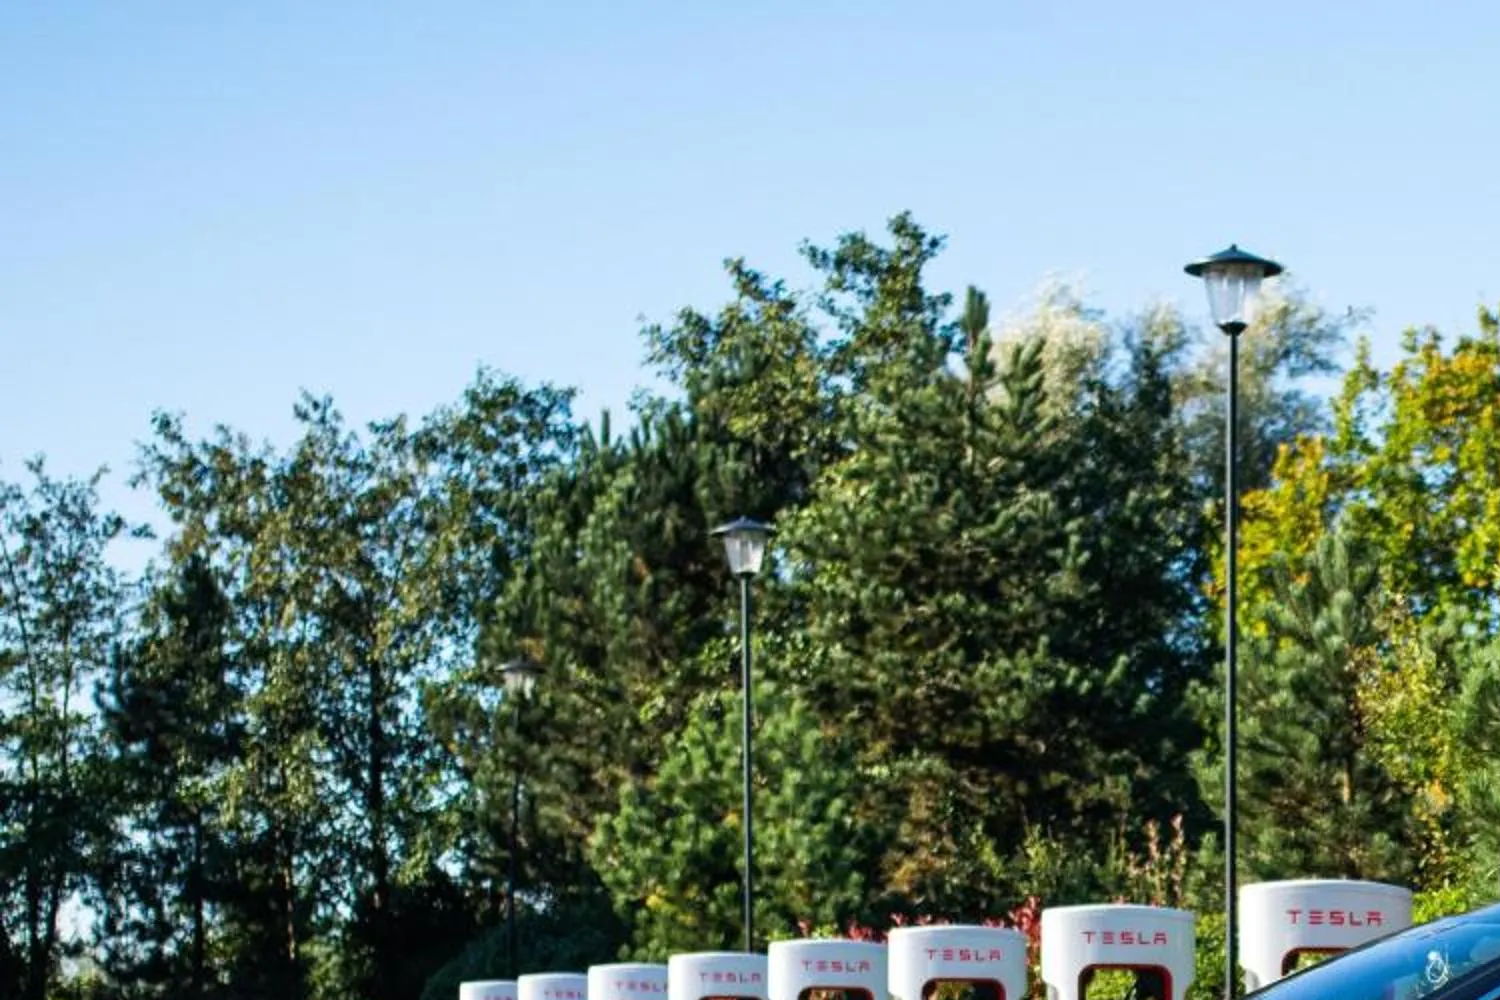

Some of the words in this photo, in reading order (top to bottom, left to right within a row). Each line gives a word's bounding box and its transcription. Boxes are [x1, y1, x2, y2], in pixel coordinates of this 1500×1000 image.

[1286, 909, 1384, 926] TESLA
[1080, 931, 1168, 945] TESLA
[926, 948, 1002, 961] TESLA
[801, 960, 871, 972] TESLA
[699, 971, 761, 984] TESLA
[614, 980, 668, 992] TESL
